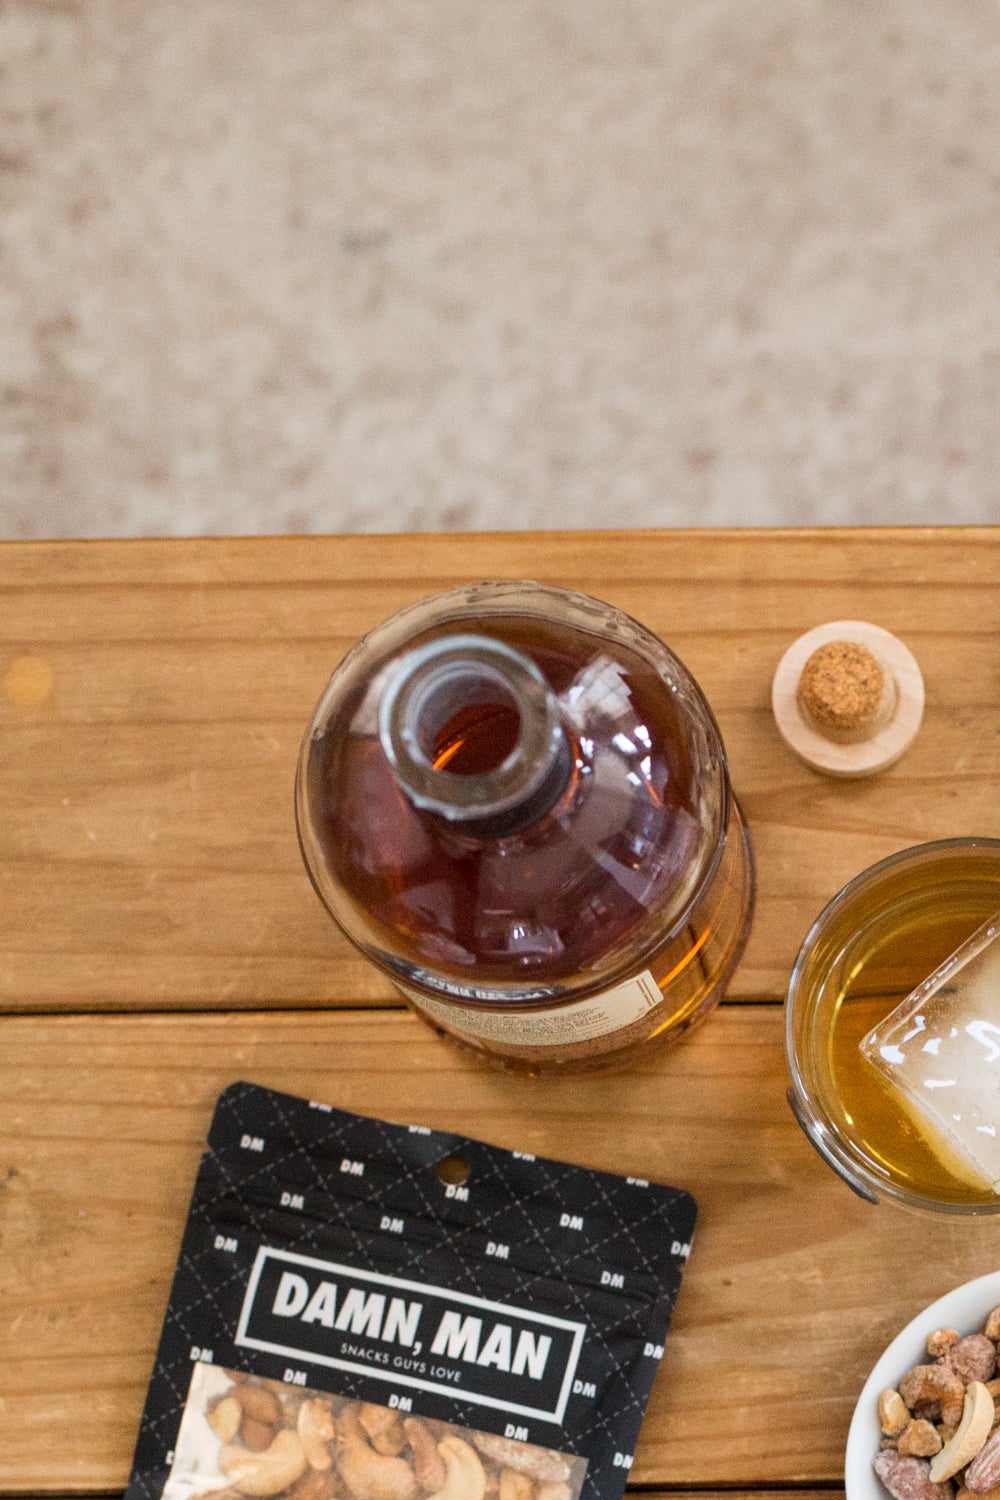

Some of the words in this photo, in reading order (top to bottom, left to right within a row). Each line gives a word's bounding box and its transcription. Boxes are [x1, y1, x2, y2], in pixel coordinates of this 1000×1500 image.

[240, 1135, 264, 1152] DM
[340, 1159, 364, 1176] DM
[280, 1192, 304, 1210] DM
[445, 1184, 469, 1202] DM
[380, 1216, 404, 1233] DM
[560, 1213, 583, 1231] DM
[214, 1235, 238, 1253] DM
[486, 1242, 510, 1260] DM
[601, 1271, 624, 1288] DM
[272, 1271, 423, 1356] DAMN,
[430, 1310, 552, 1380] MAN
[190, 1346, 213, 1363] DM
[340, 1342, 389, 1364] SNACKS
[394, 1356, 426, 1374] GUYS
[430, 1364, 462, 1382] LOVE
[284, 1368, 307, 1386] DM
[573, 1380, 596, 1398] DM
[388, 1394, 412, 1412] DM
[504, 1424, 528, 1441] DM
